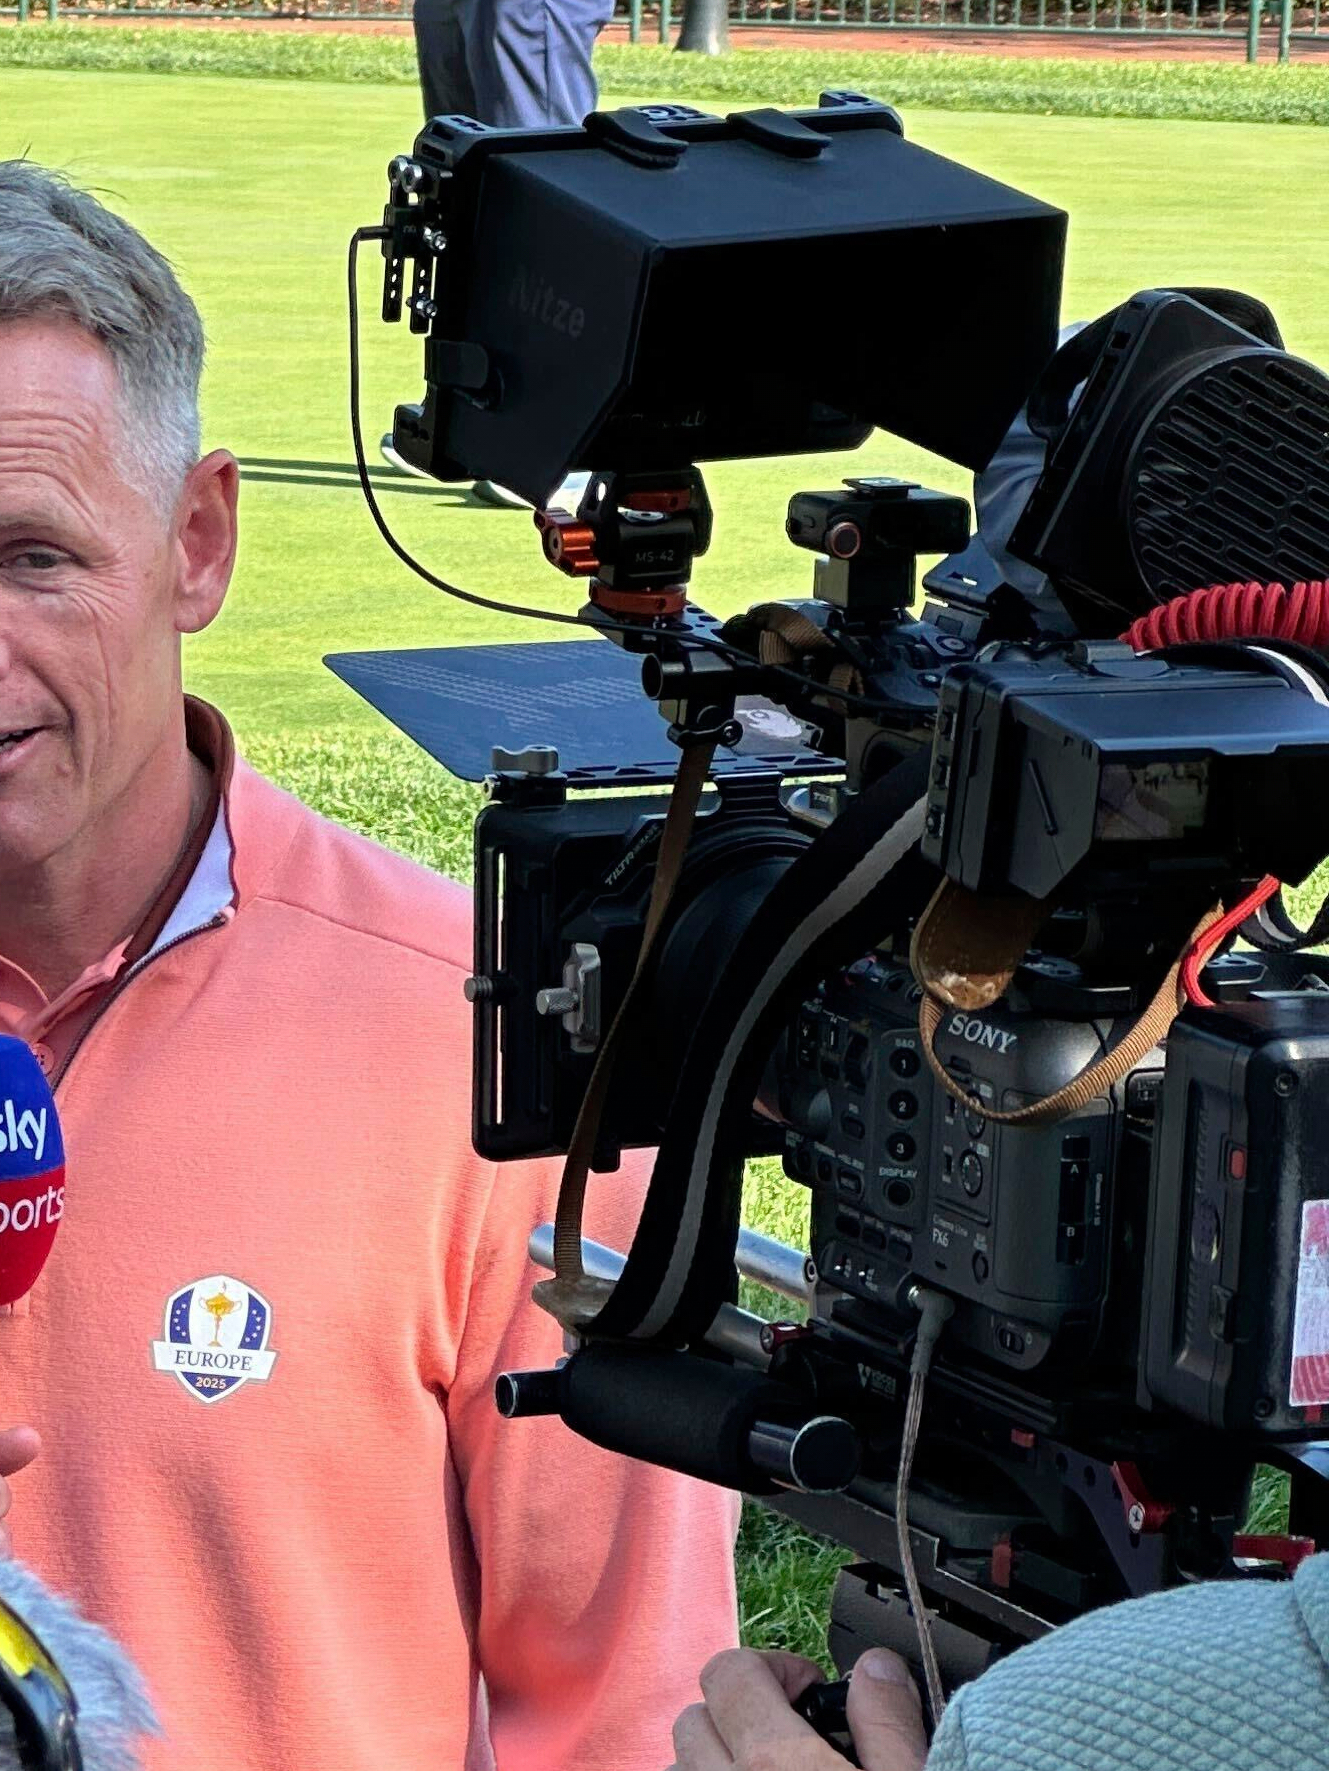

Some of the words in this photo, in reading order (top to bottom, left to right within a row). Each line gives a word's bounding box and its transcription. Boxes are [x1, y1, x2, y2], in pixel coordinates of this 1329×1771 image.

[948, 1012, 1018, 1054] SONY
[900, 1058, 907, 1070] 1
[898, 1101, 907, 1113] 2
[896, 1142, 905, 1154] 3
[878, 1166, 918, 1179] DISPLAY
[1069, 1163, 1080, 1174] A
[932, 1227, 949, 1248] FX6
[174, 1349, 253, 1371] EUROPE
[195, 1376, 227, 1390] 2025
